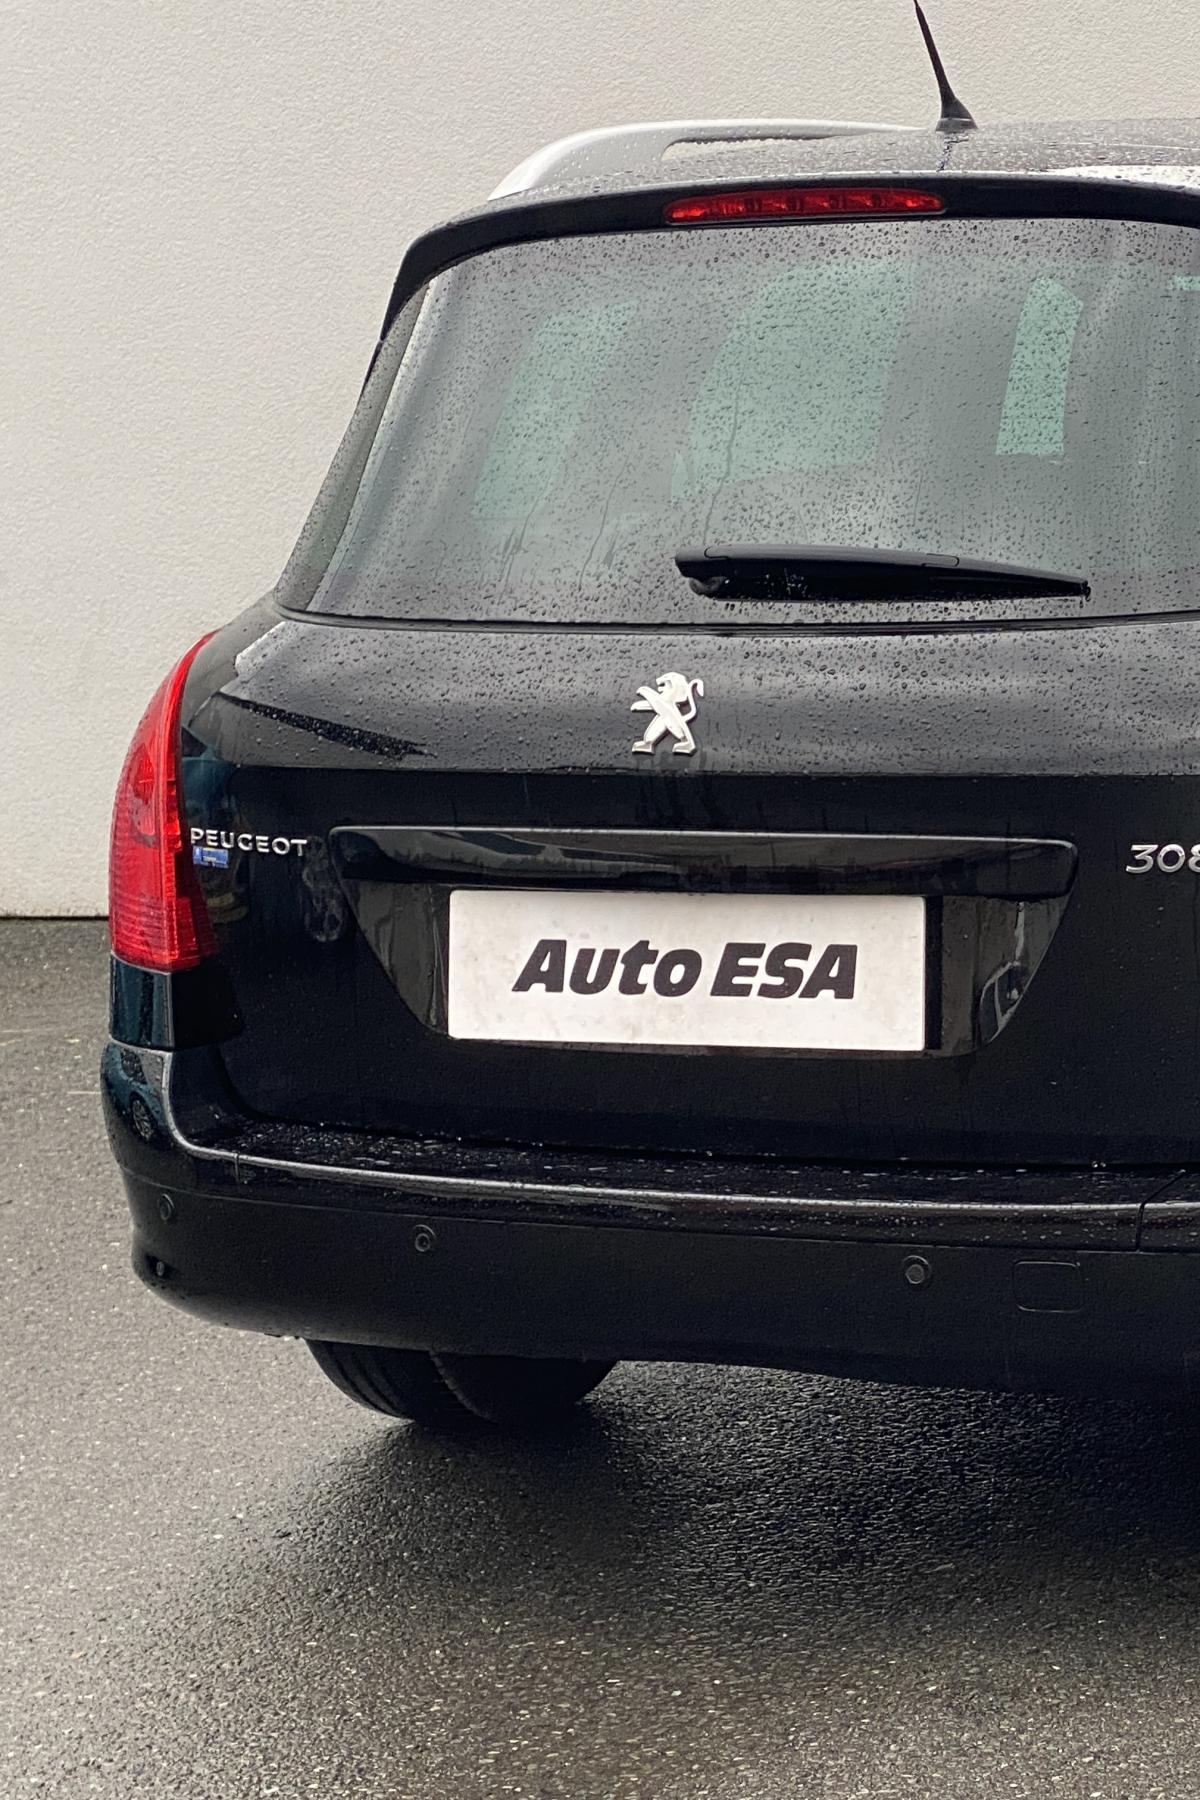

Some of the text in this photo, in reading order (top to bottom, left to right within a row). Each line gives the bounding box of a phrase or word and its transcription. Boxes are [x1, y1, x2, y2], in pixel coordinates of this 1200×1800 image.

[190, 828, 307, 857] PEUGEOT
[512, 939, 858, 1000] Auto ESA
